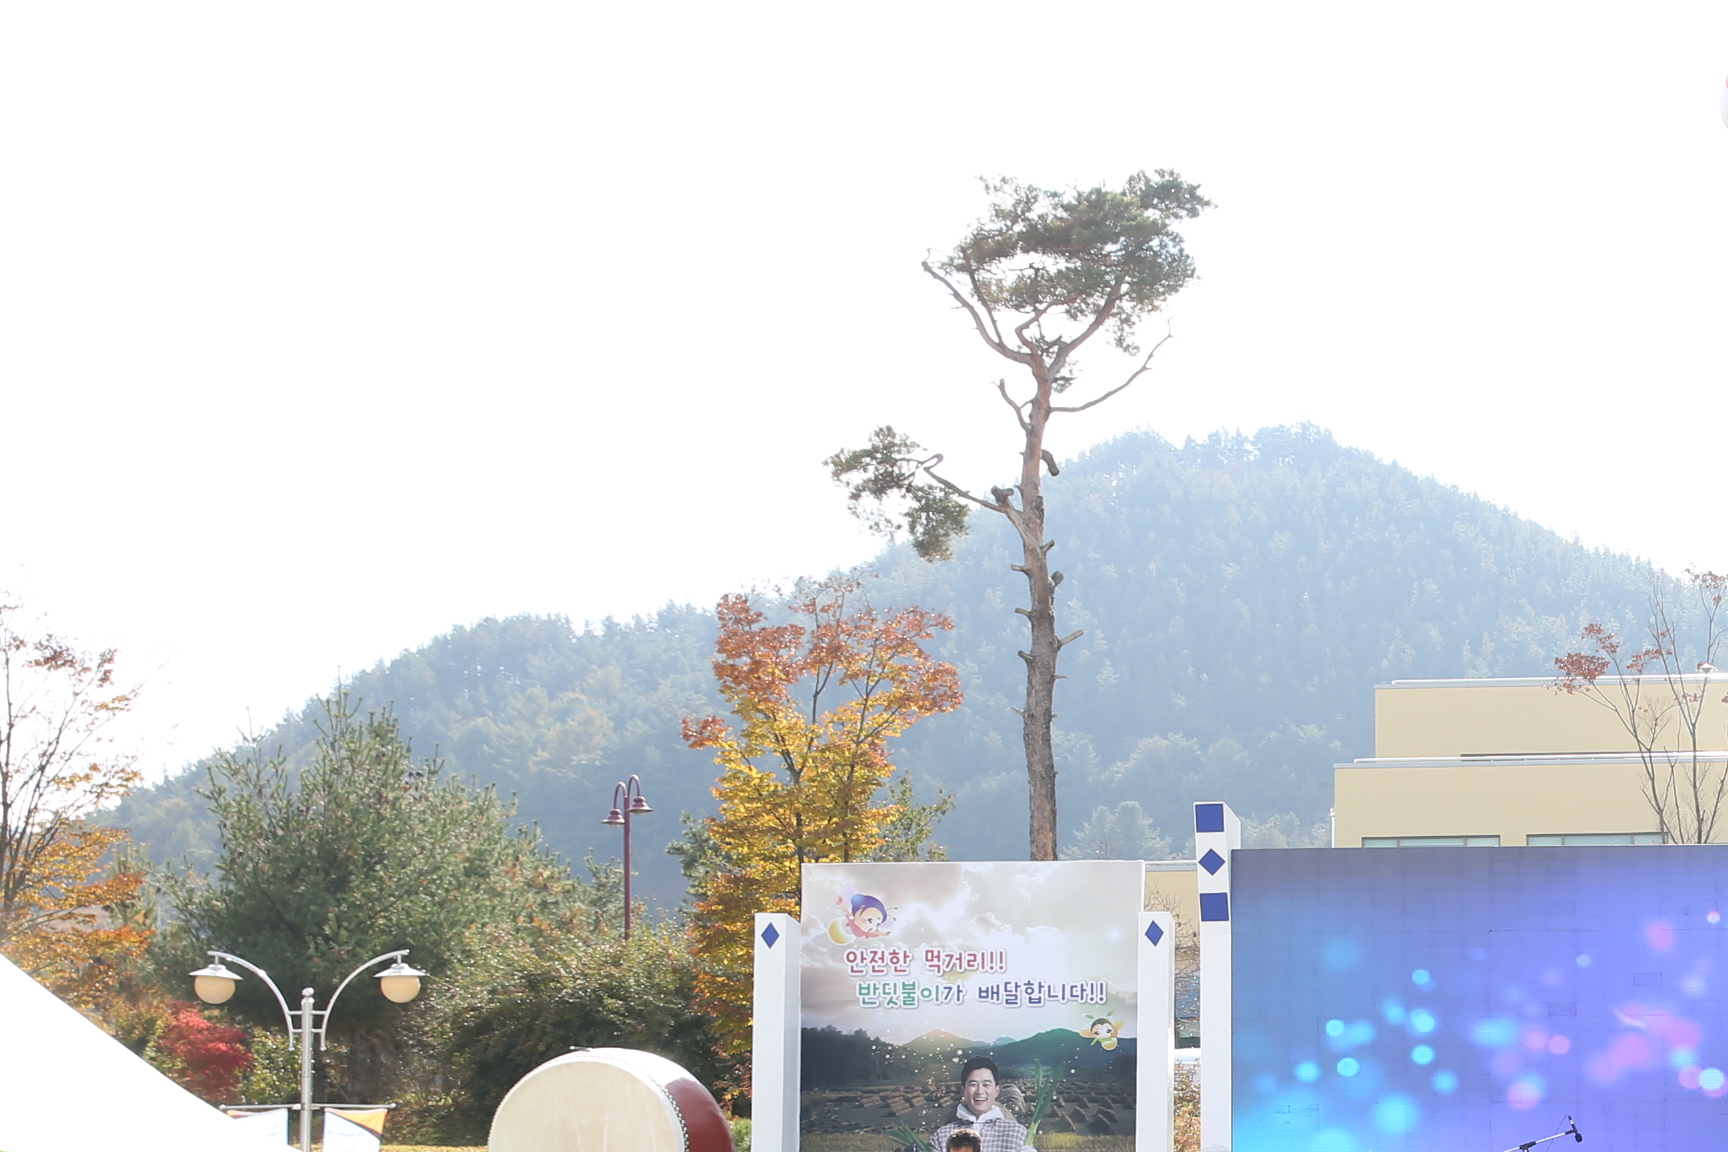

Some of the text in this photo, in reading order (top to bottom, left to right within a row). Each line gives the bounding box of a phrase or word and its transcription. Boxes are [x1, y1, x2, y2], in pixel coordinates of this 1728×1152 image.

[844, 949, 1005, 974] 안전한 먹거리!!
[858, 980, 1107, 1006] 반딧불이가 배달합니다!!
